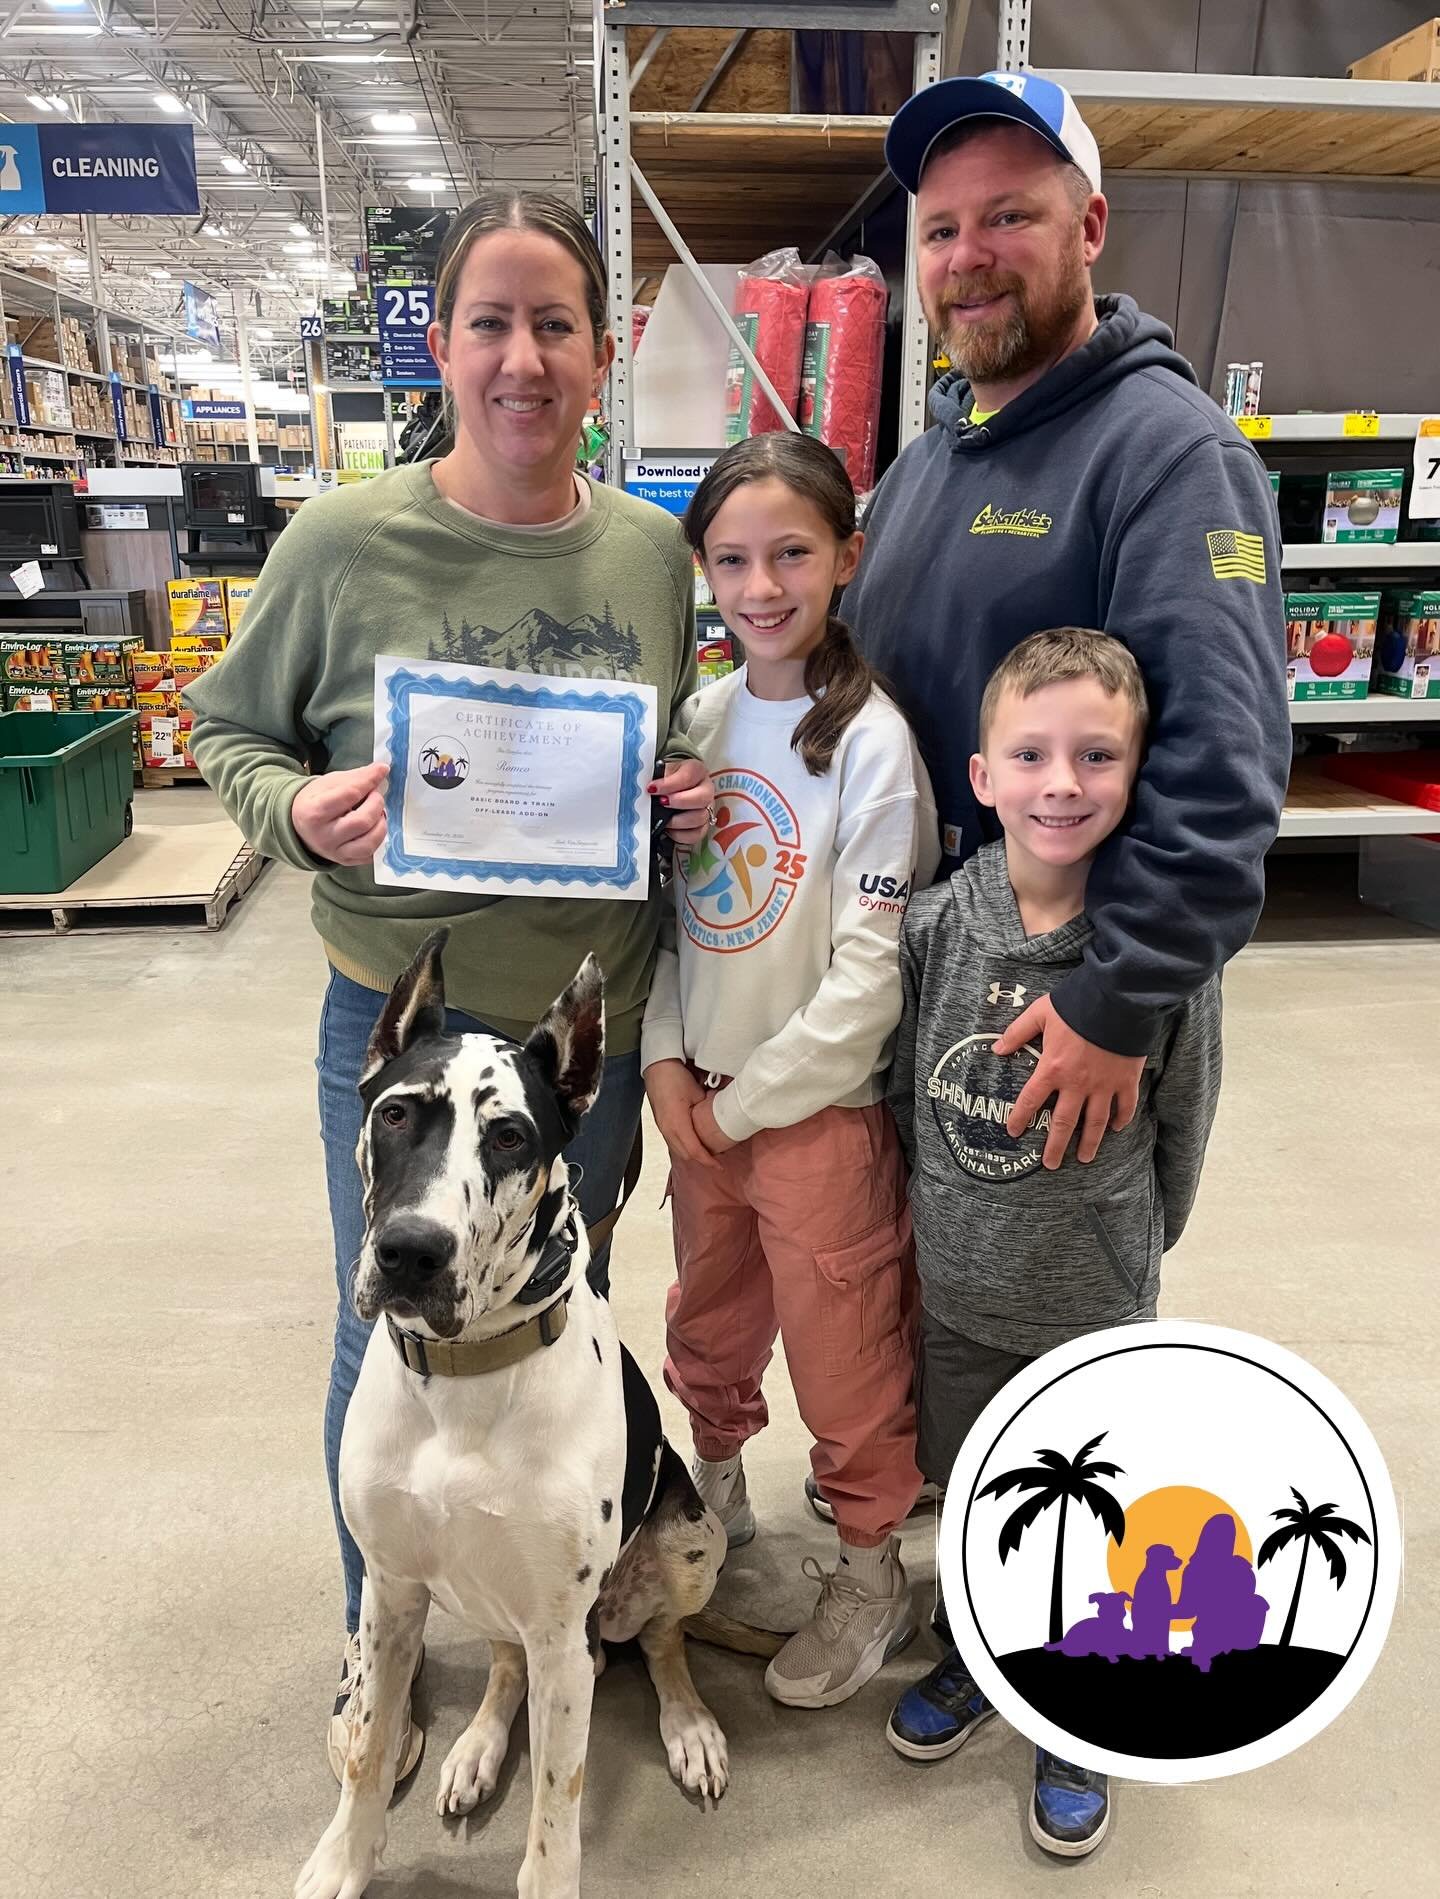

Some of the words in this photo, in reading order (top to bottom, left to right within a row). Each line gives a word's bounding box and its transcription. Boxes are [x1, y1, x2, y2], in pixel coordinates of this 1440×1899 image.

[52, 157, 160, 177] CLEANING
[384, 290, 430, 326] 25
[301, 320, 321, 337] 26
[196, 406, 241, 414] APPLIANCES
[344, 439, 377, 450] PATENTED
[345, 451, 384, 469] TECHN
[637, 465, 701, 477] Download
[638, 487, 657, 498] The
[659, 487, 681, 498] best
[171, 588, 210, 599] duraflame
[230, 588, 253, 598] duraf
[1, 641, 42, 652] Enviro-Log
[65, 643, 99, 652] Enviro-Log
[151, 664, 165, 672] start
[175, 665, 191, 673] quick
[191, 665, 206, 673] start
[9, 686, 50, 696] Enviro-Log
[77, 688, 111, 697] Enviro-Log
[456, 711, 554, 731] CERTIFICATE
[563, 722, 582, 733] OF
[463, 728, 573, 746] ACHIEVEMENT
[719, 775, 794, 837] CHAMPIONSHIPS
[774, 850, 808, 880] 25
[859, 873, 909, 900] USA
[726, 927, 755, 947] NEW
[758, 887, 789, 934] JERSEY
[944, 1120, 996, 1176] NATIONAL
[1002, 1149, 1042, 1176] PARK
